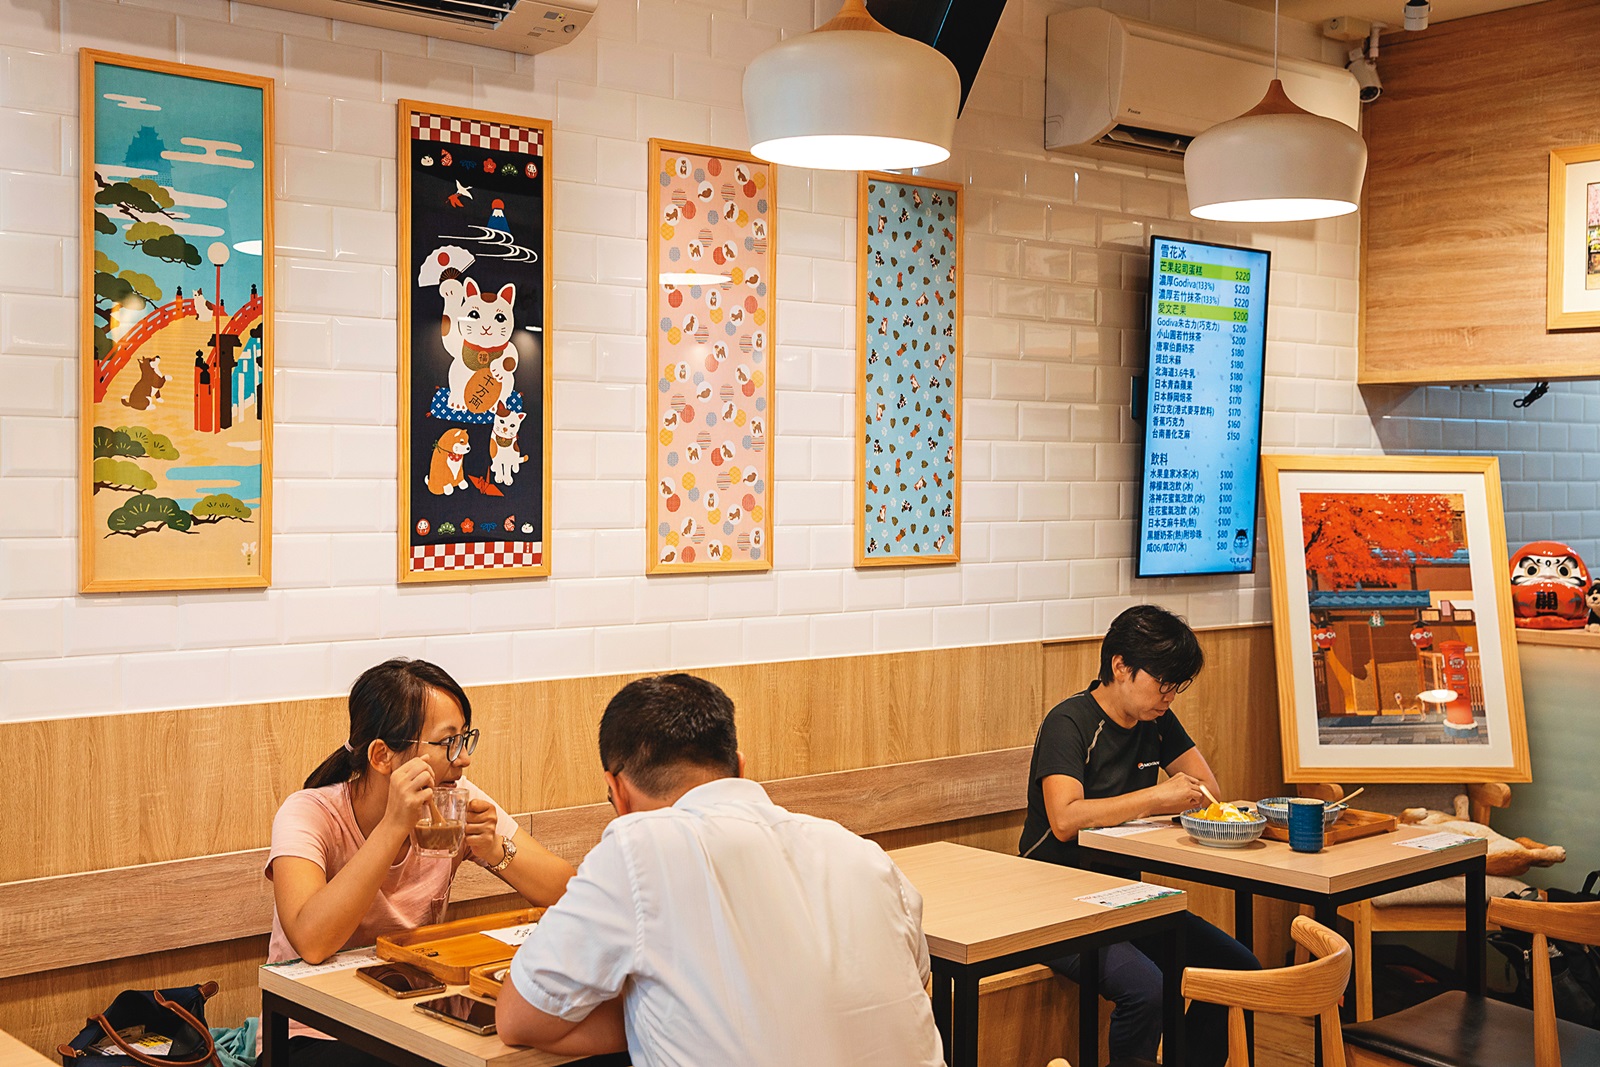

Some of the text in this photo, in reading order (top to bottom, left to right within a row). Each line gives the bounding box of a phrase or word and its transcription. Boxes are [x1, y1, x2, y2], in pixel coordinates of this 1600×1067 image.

[1161, 244, 1186, 259] 雪花冰
[1160, 261, 1250, 281] 芒果起司蛋糕 $220
[1235, 284, 1250, 295] $220
[1234, 298, 1249, 308] $220
[1158, 303, 1248, 321] 愛文芒果 $200
[1233, 324, 1246, 333] $200
[1232, 334, 1246, 345] $200
[1231, 349, 1244, 357] $180
[1231, 361, 1243, 369] $180
[1230, 372, 1243, 381] $180
[1230, 385, 1242, 393] $180
[1229, 396, 1241, 404] $170
[1228, 408, 1241, 417] $170
[1228, 420, 1240, 428] $160
[1227, 432, 1240, 441] $150
[1151, 453, 1168, 466] 飲料
[1220, 470, 1233, 479] $100
[1220, 482, 1233, 491] $100
[1219, 494, 1232, 502] $100
[1219, 506, 1231, 515] $100
[1218, 518, 1231, 526] $100
[1218, 530, 1228, 538] $80
[1217, 542, 1227, 550] $80
